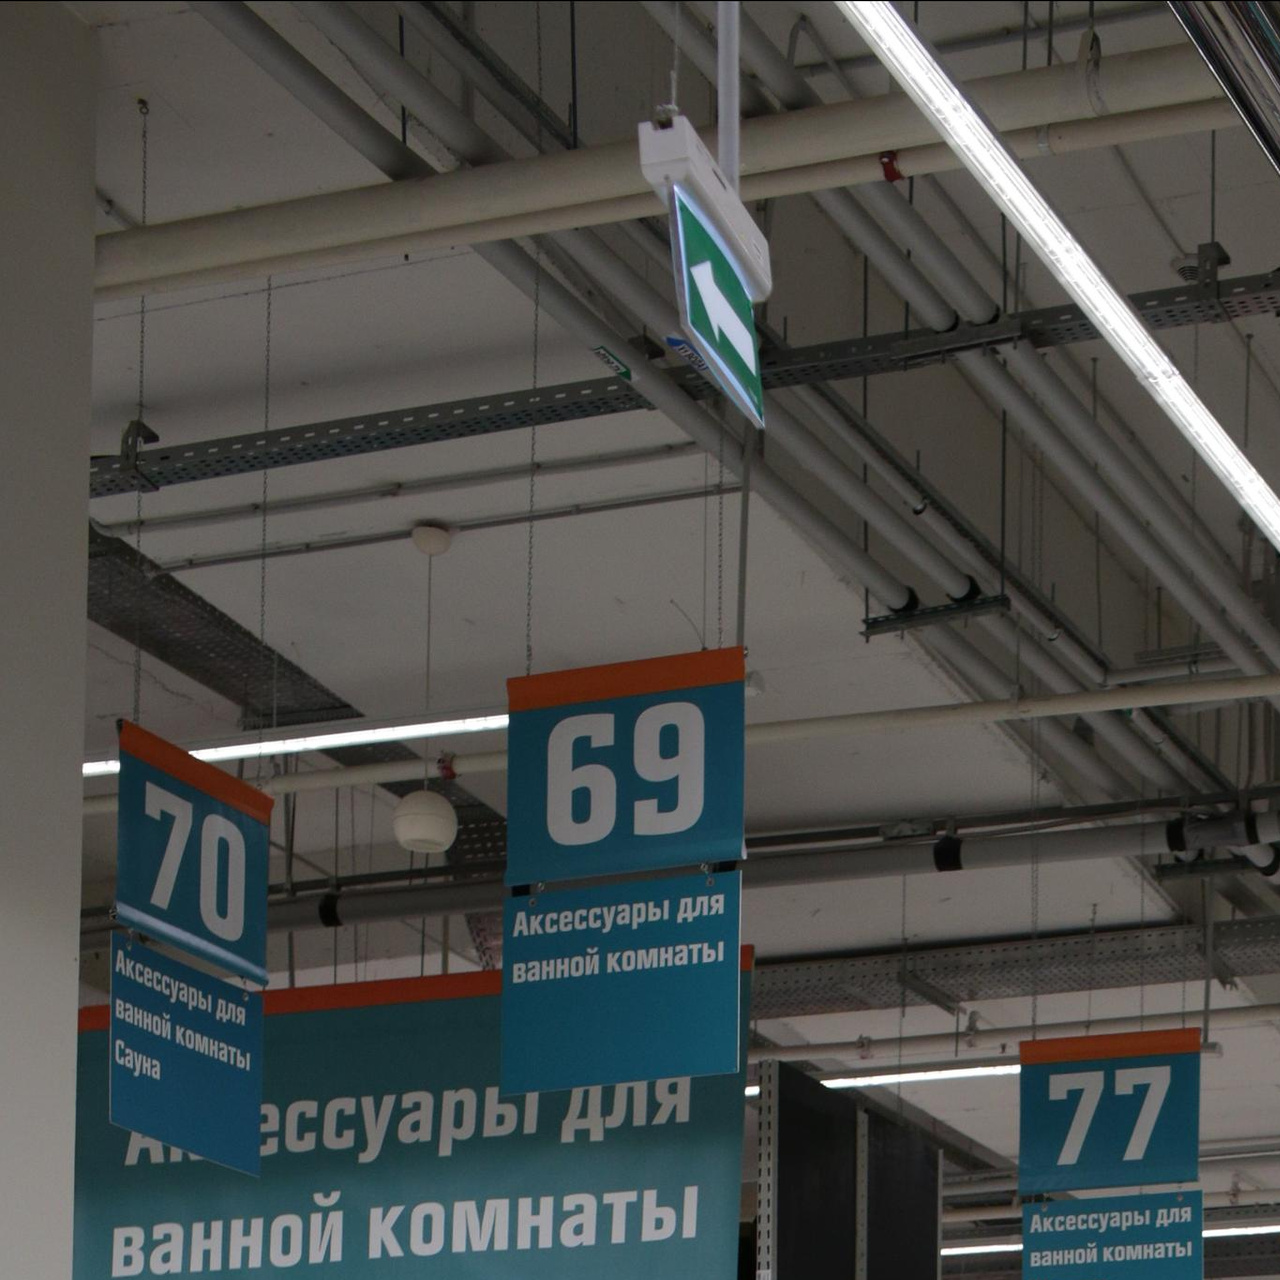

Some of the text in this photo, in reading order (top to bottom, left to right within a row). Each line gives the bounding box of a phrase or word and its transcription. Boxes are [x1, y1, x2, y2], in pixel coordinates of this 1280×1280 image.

[546, 701, 707, 848] 69
[144, 780, 246, 943] 70
[513, 892, 725, 938] Аксессуары для
[115, 949, 246, 1026] Аксессуары для
[512, 939, 725, 985] ванной комнаты
[114, 1039, 161, 1081] Сауна
[115, 997, 251, 1072] ванной комнаты
[561, 1074, 692, 1144] для
[1049, 1065, 1172, 1166] 77
[111, 1184, 700, 1279] ванной комнаты
[1030, 1206, 1192, 1234] Аксессуары для
[1030, 1241, 1193, 1267] ванной комнаты
